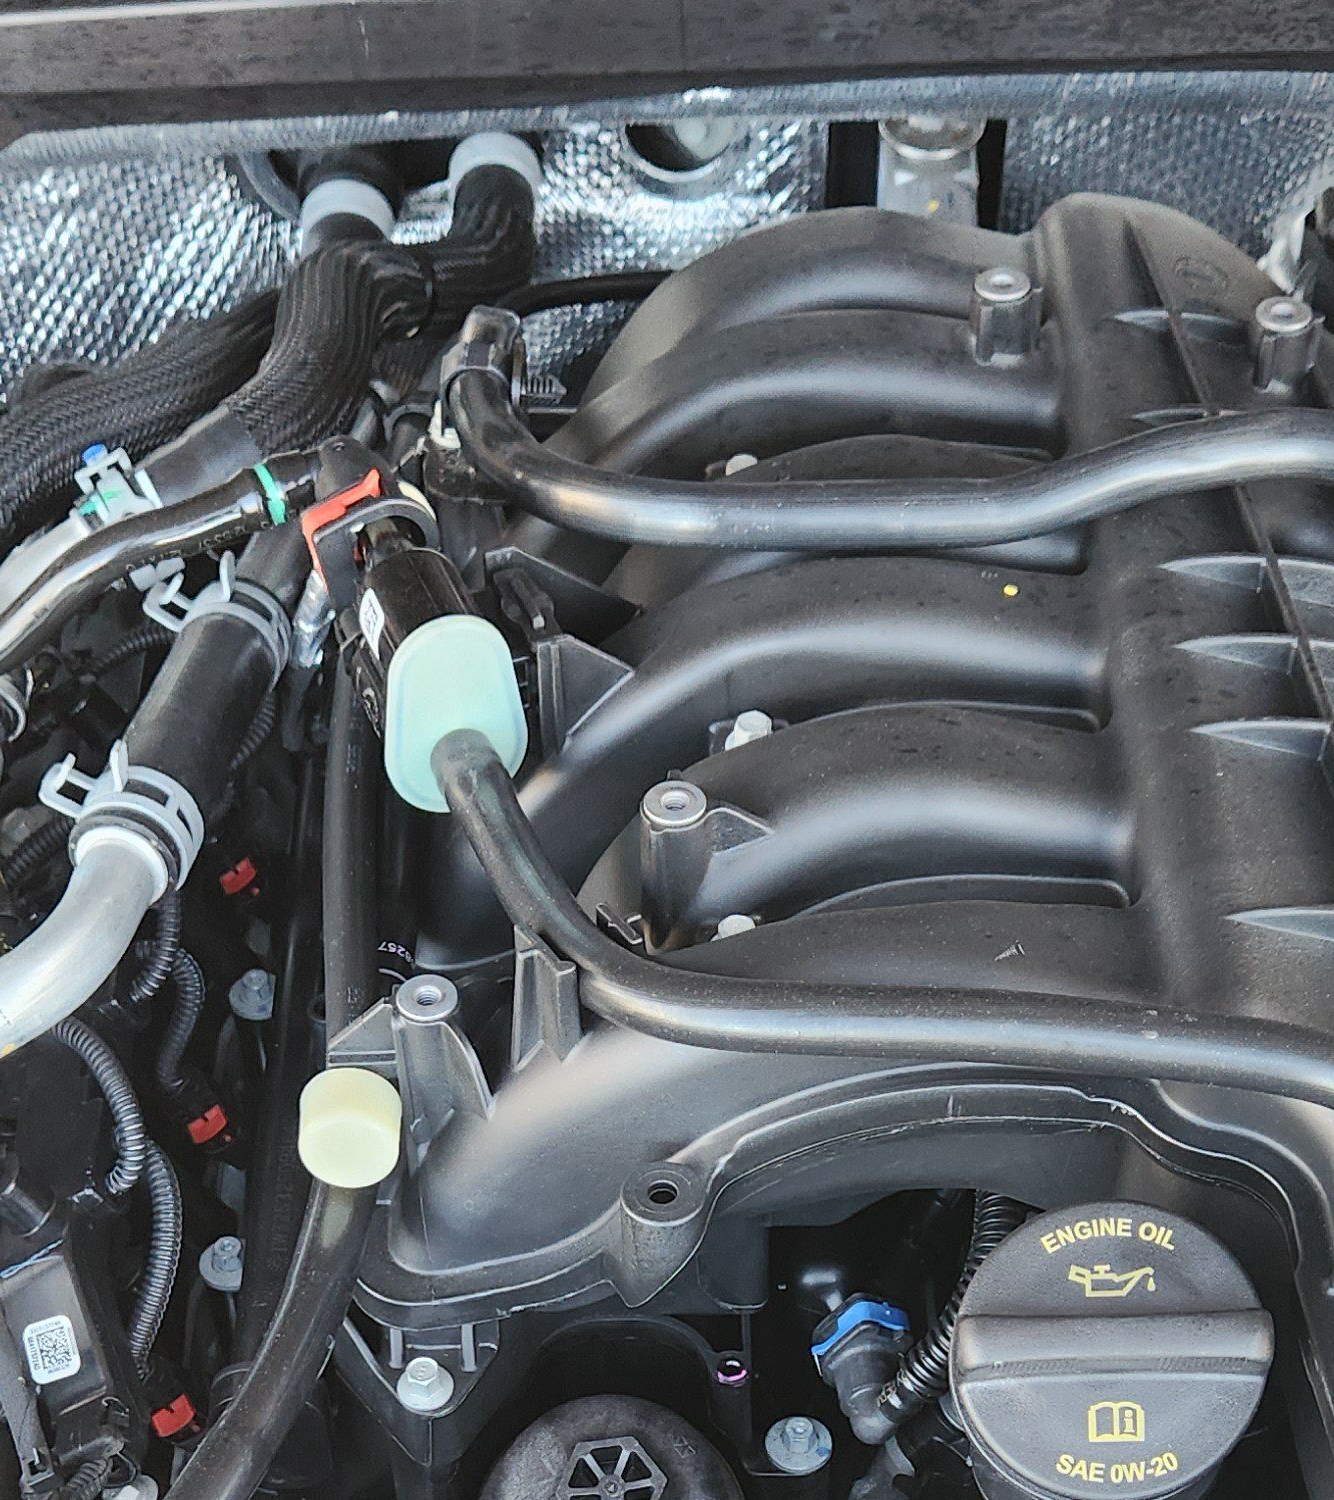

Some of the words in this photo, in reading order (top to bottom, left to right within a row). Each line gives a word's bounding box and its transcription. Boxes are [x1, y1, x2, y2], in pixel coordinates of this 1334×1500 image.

[1040, 1217, 1132, 1255] ENGINE
[1137, 1222, 1177, 1251] OIL
[1055, 1454, 1105, 1484] SAE
[1109, 1452, 1179, 1484] 0W-20
